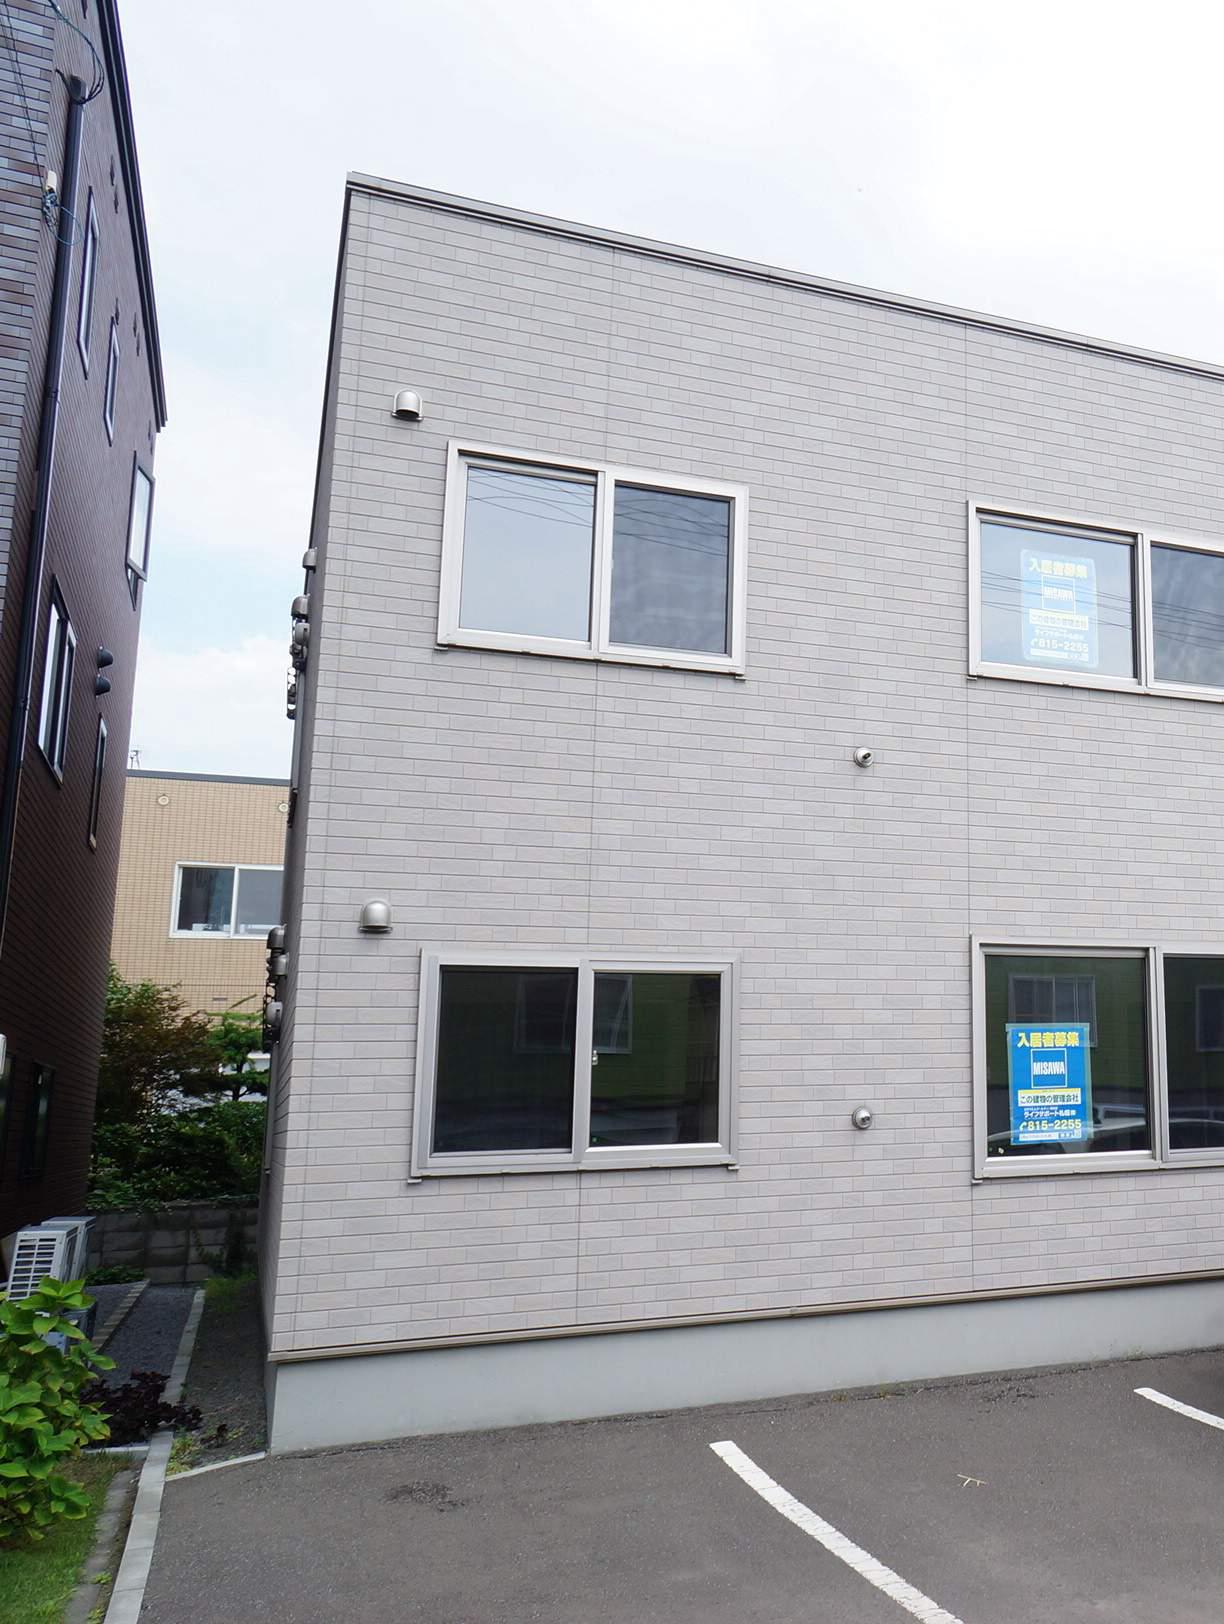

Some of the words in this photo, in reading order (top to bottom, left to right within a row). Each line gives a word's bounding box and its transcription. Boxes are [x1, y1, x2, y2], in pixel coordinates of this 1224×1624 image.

[1017, 1032, 1079, 1048] 入居者募集
[1033, 1061, 1065, 1075] MISAWA
[1028, 1119, 1081, 1130] 815-2255
